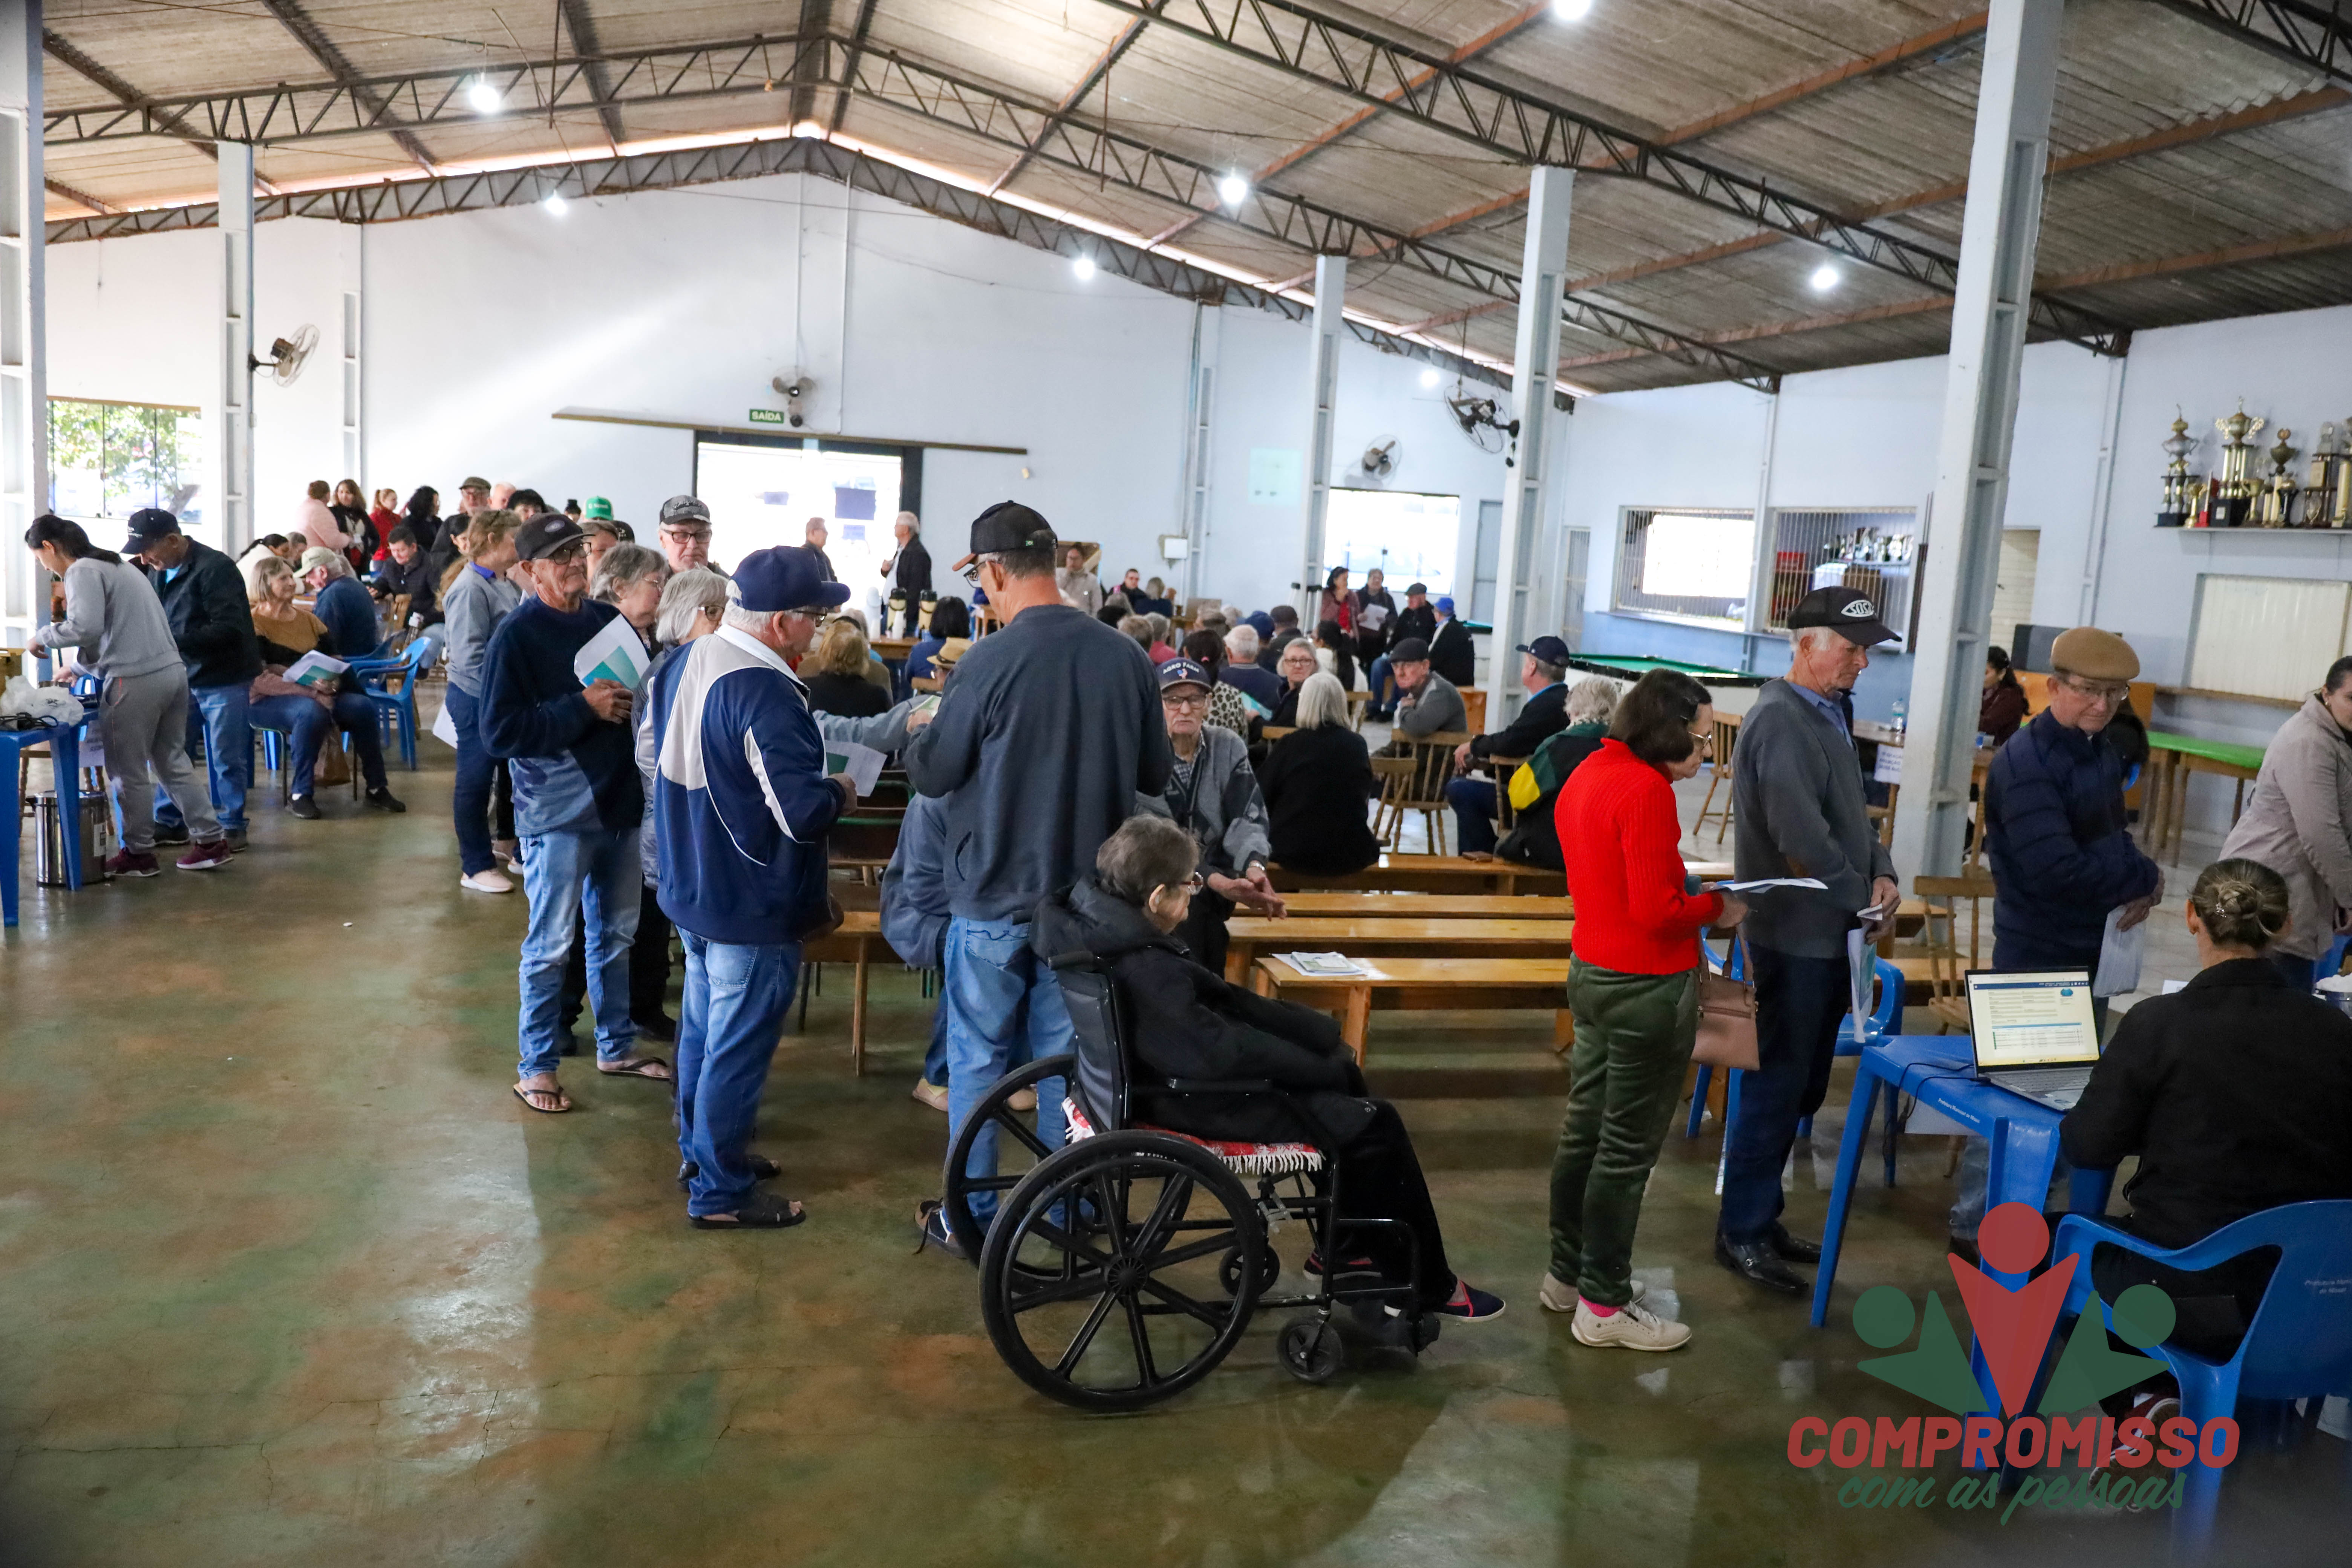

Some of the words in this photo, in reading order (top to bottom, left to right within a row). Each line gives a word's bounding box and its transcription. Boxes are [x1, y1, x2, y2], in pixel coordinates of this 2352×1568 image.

[752, 410, 781, 421] SAÍDA
[1163, 662, 1181, 674] AGRO
[1183, 662, 1199, 673] FARM
